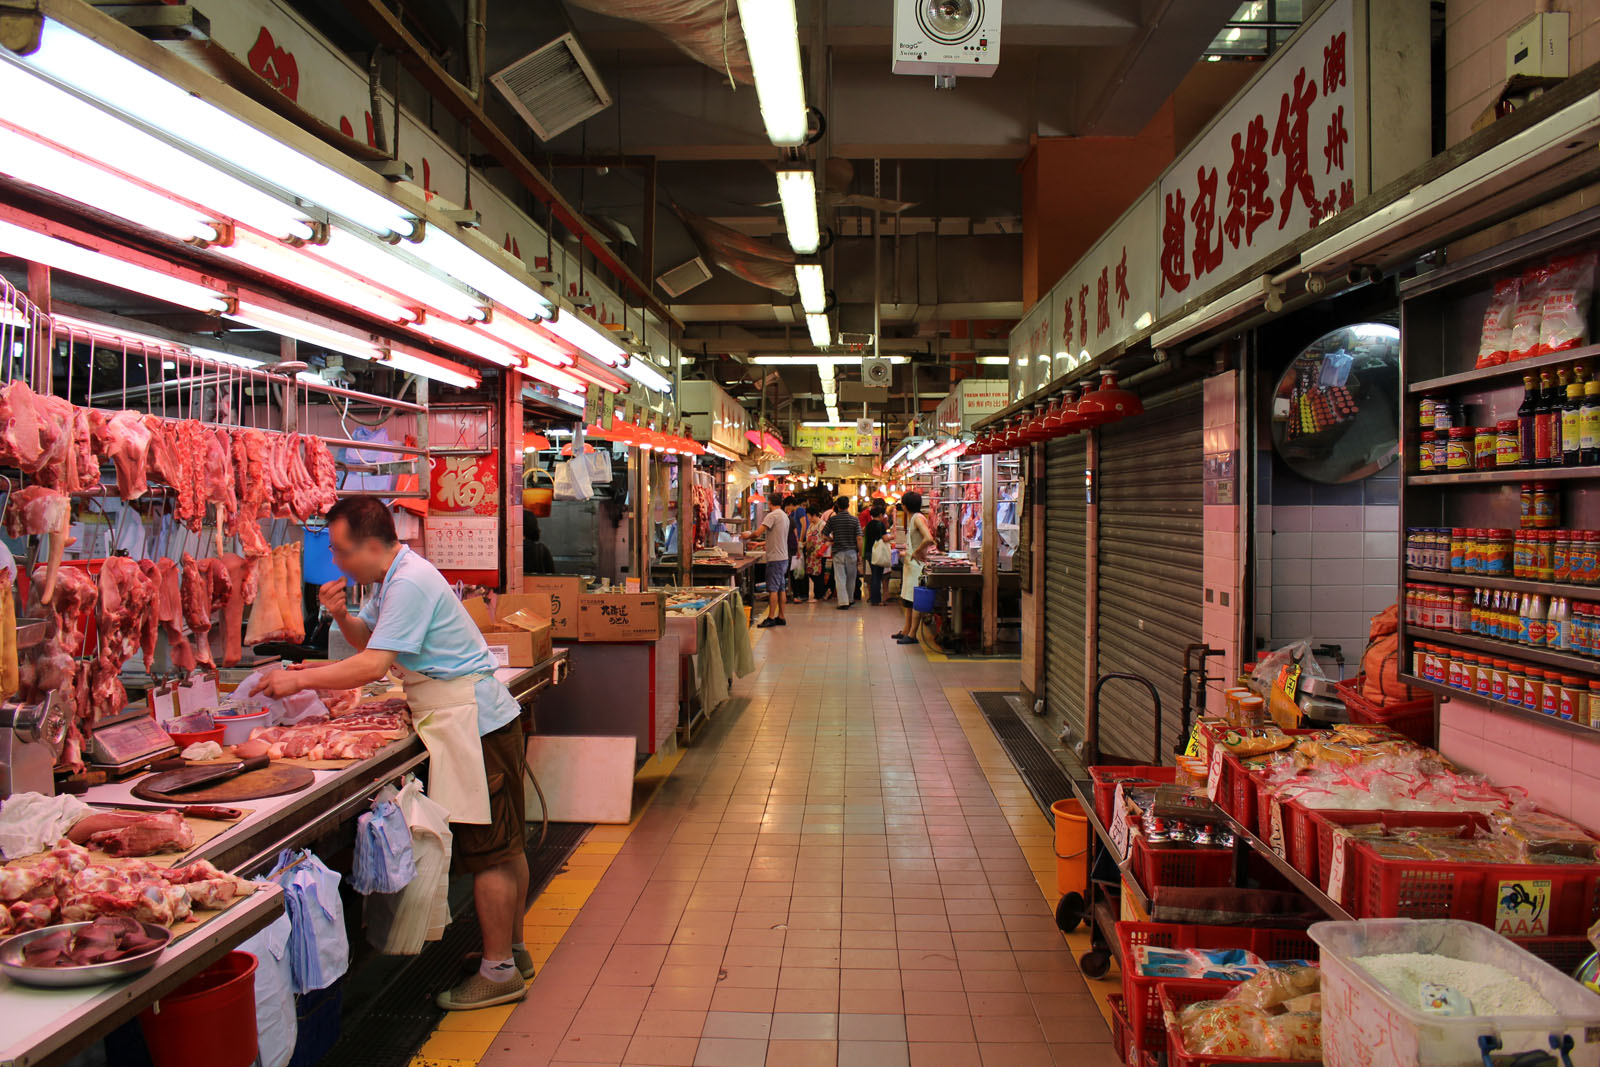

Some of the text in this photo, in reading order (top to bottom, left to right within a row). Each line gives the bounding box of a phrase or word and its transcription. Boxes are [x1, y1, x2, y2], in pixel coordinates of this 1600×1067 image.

[1323, 31, 1348, 175] 潮州
[1160, 67, 1318, 298] 趙記雜貨
[437, 455, 486, 508] 福
[1498, 918, 1546, 935] AAA
